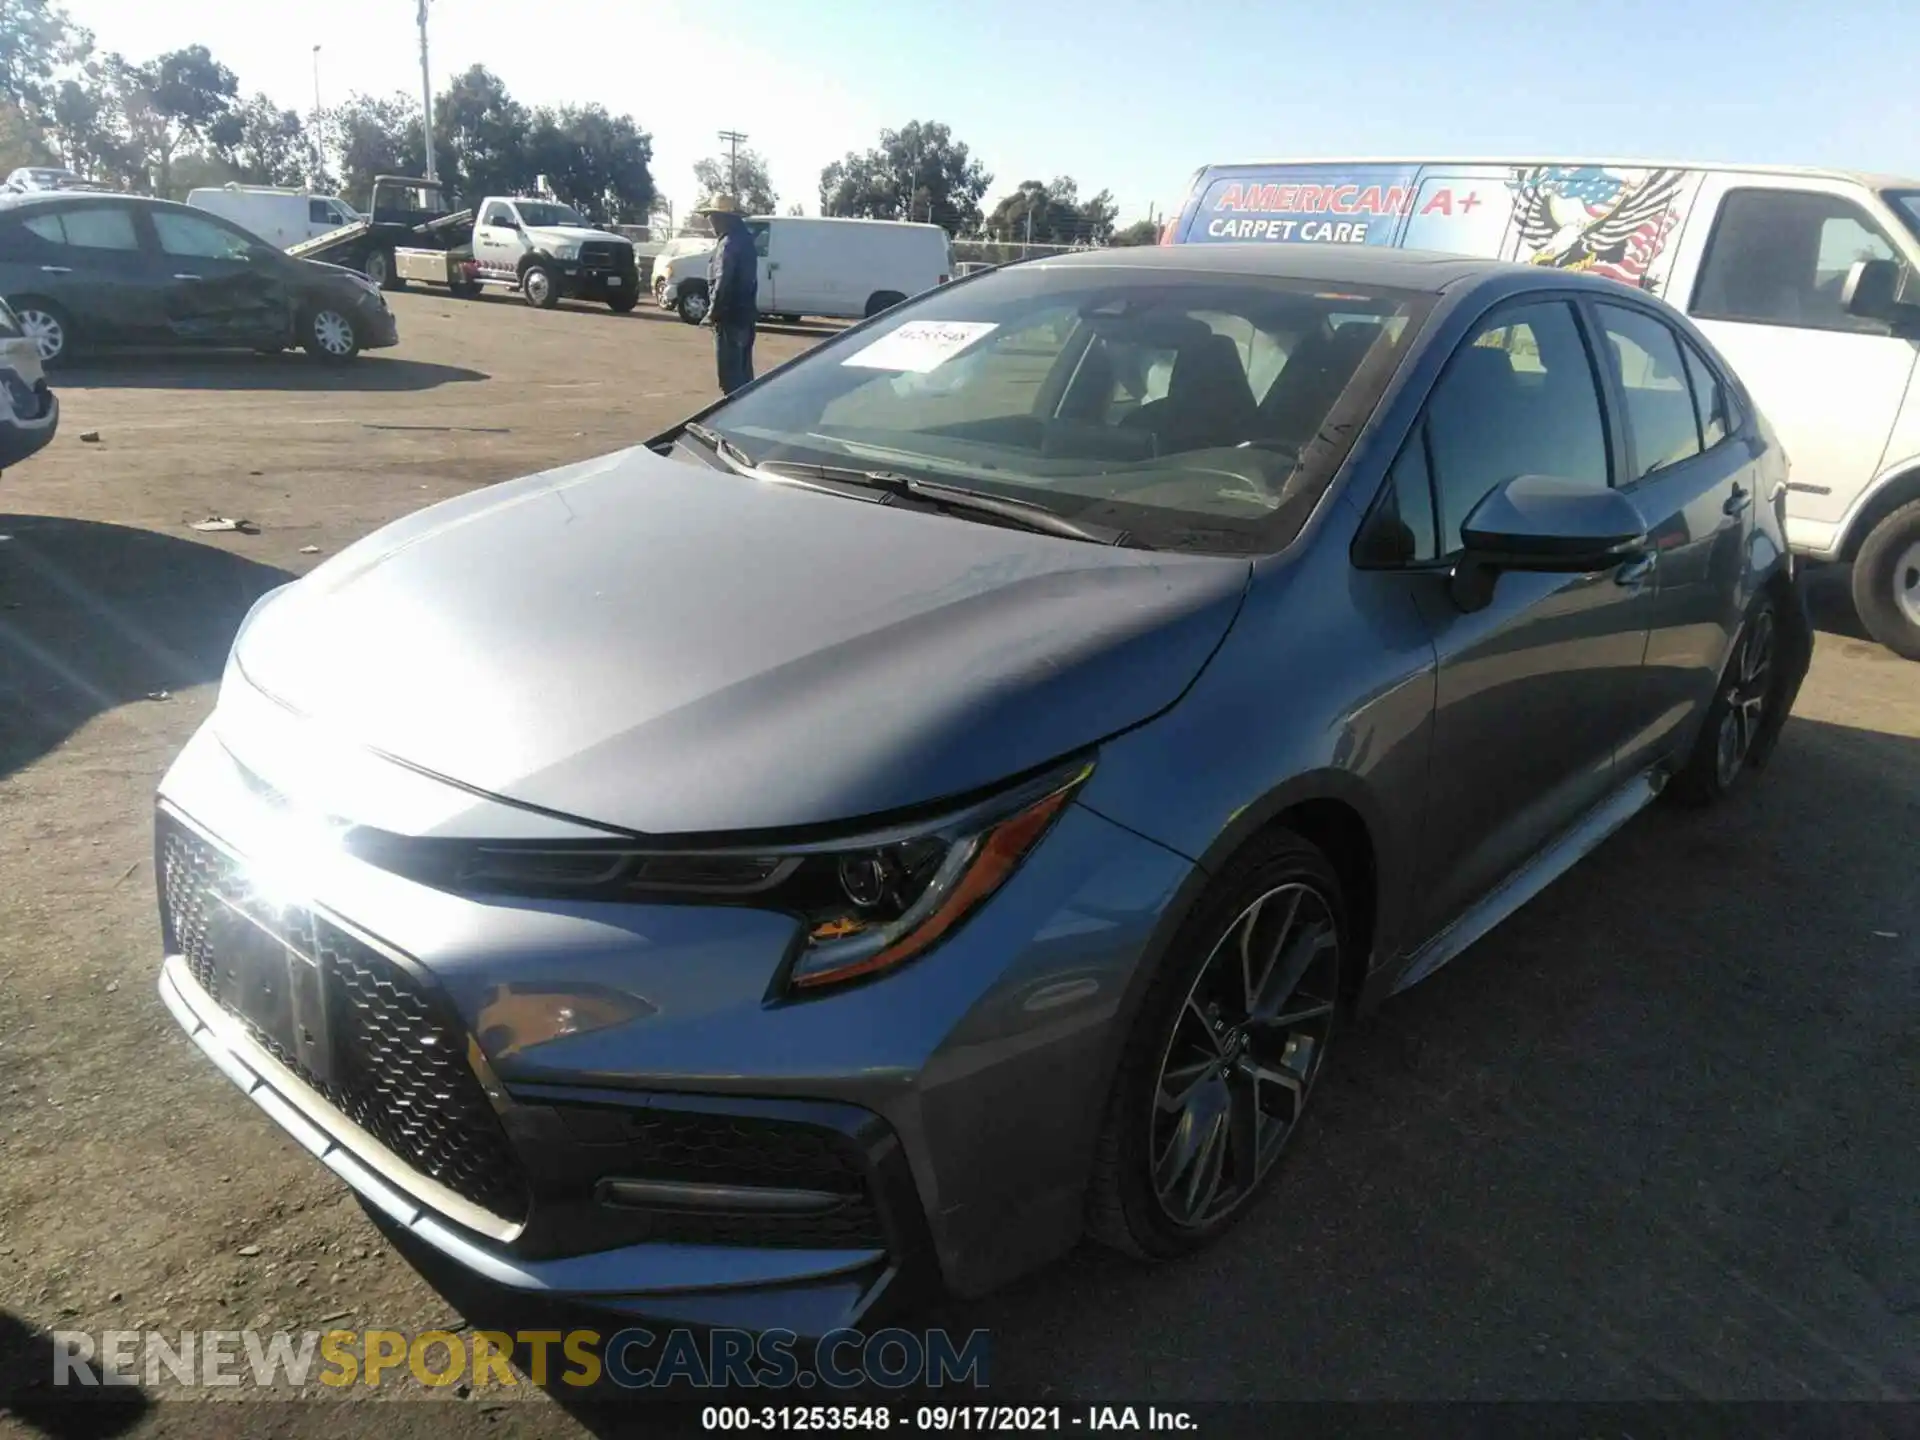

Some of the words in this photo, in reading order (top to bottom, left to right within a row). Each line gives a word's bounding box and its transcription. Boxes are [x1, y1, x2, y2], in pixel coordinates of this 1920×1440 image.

[1213, 184, 1418, 216] AMERICAN
[1419, 187, 1482, 216] A+
[1208, 219, 1297, 240] CARPET
[1300, 221, 1368, 243] CARE
